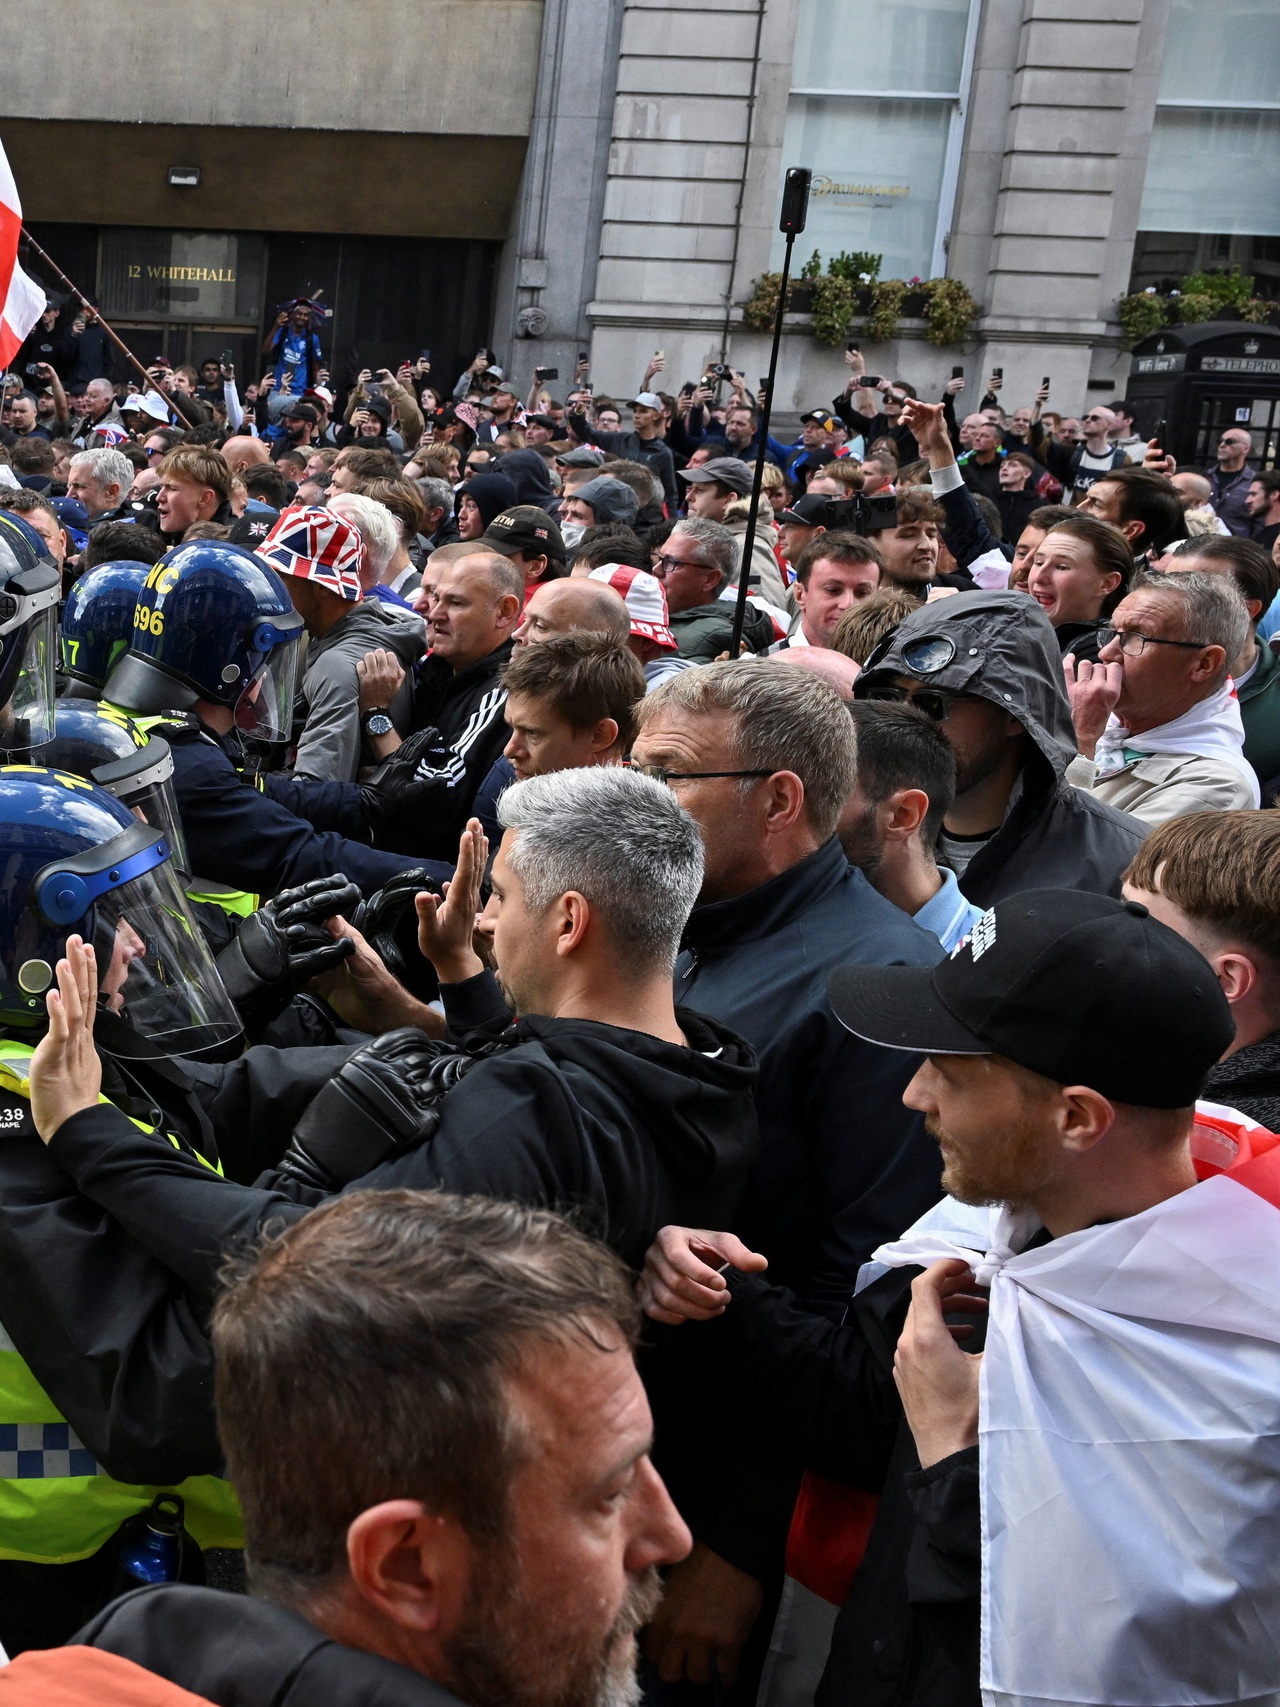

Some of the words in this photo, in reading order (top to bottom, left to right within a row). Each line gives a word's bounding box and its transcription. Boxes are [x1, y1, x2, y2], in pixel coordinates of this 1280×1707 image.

[128, 265, 141, 278] 12
[147, 265, 236, 282] WHITEHALL
[1223, 359, 1280, 372] TELEPHO
[143, 562, 180, 595] NC
